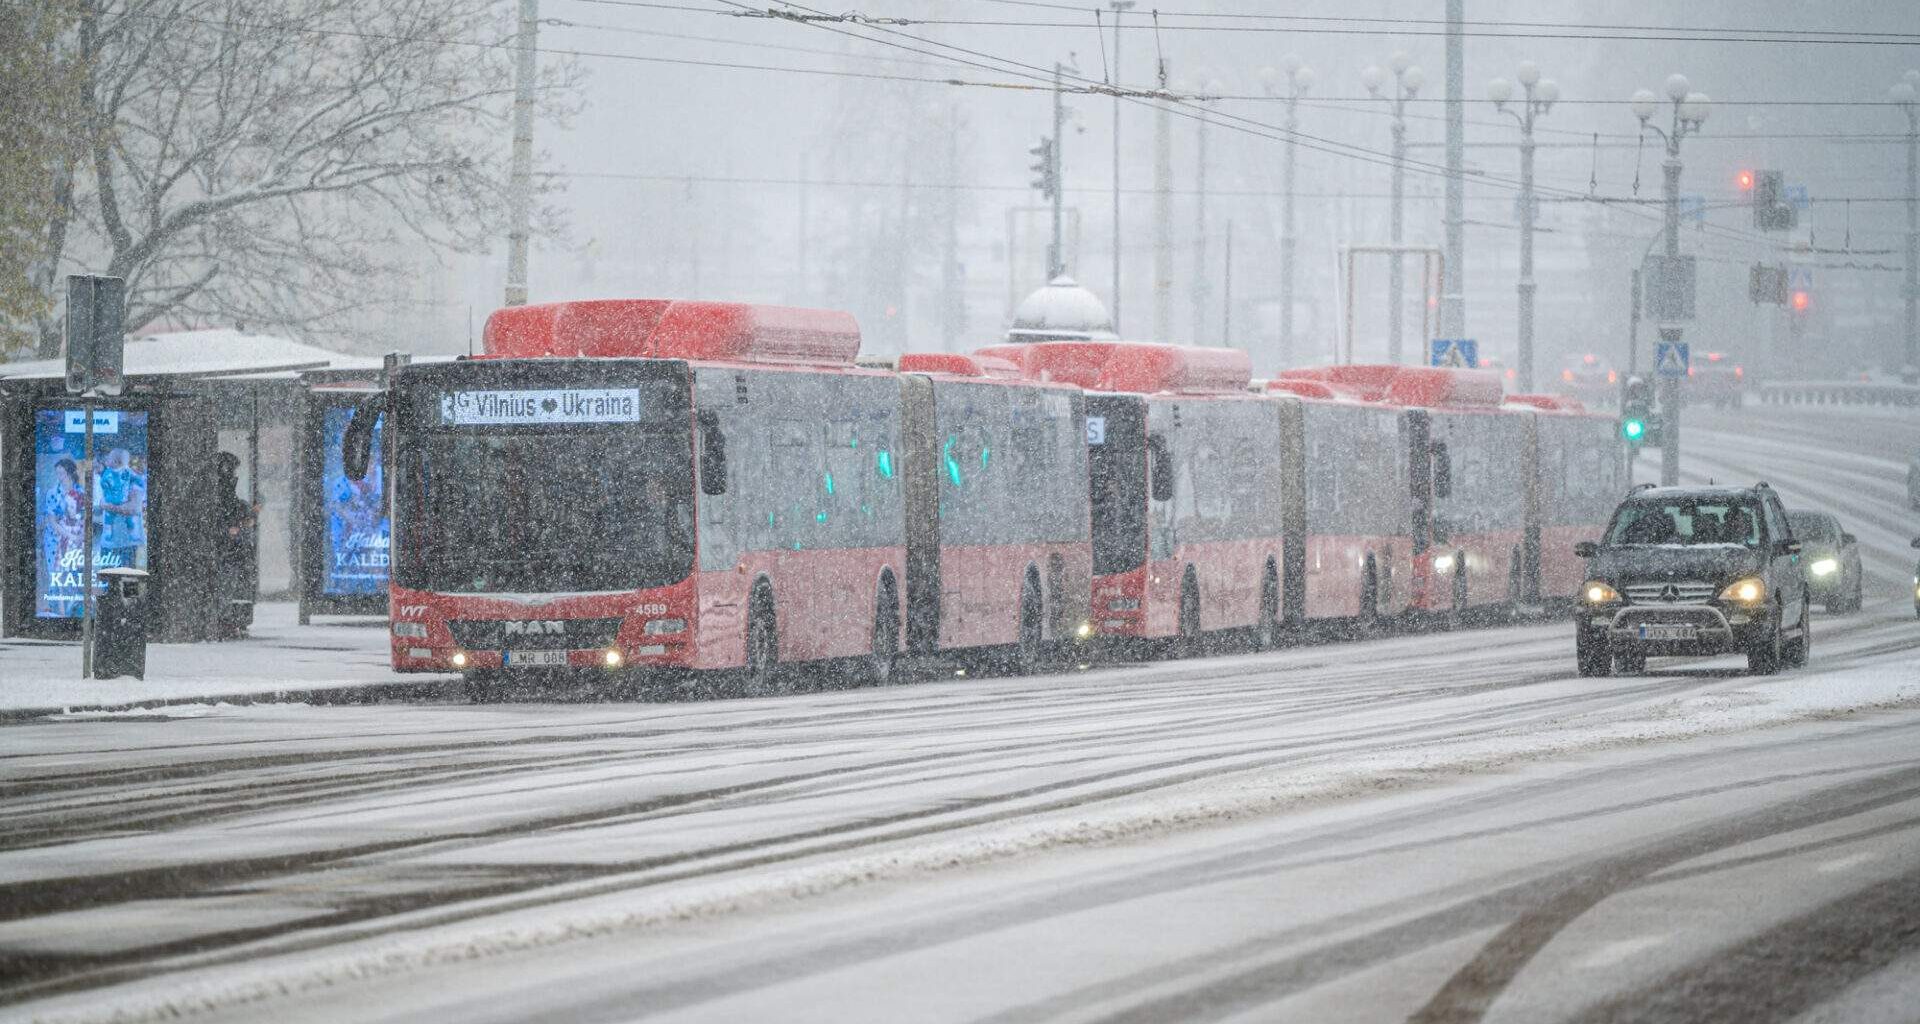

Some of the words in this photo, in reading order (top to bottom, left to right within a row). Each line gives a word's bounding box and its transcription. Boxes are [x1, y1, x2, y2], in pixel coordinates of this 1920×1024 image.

[475, 394, 536, 416] Vilnius
[562, 393, 632, 416] Ukraina
[505, 621, 564, 634] MAN
